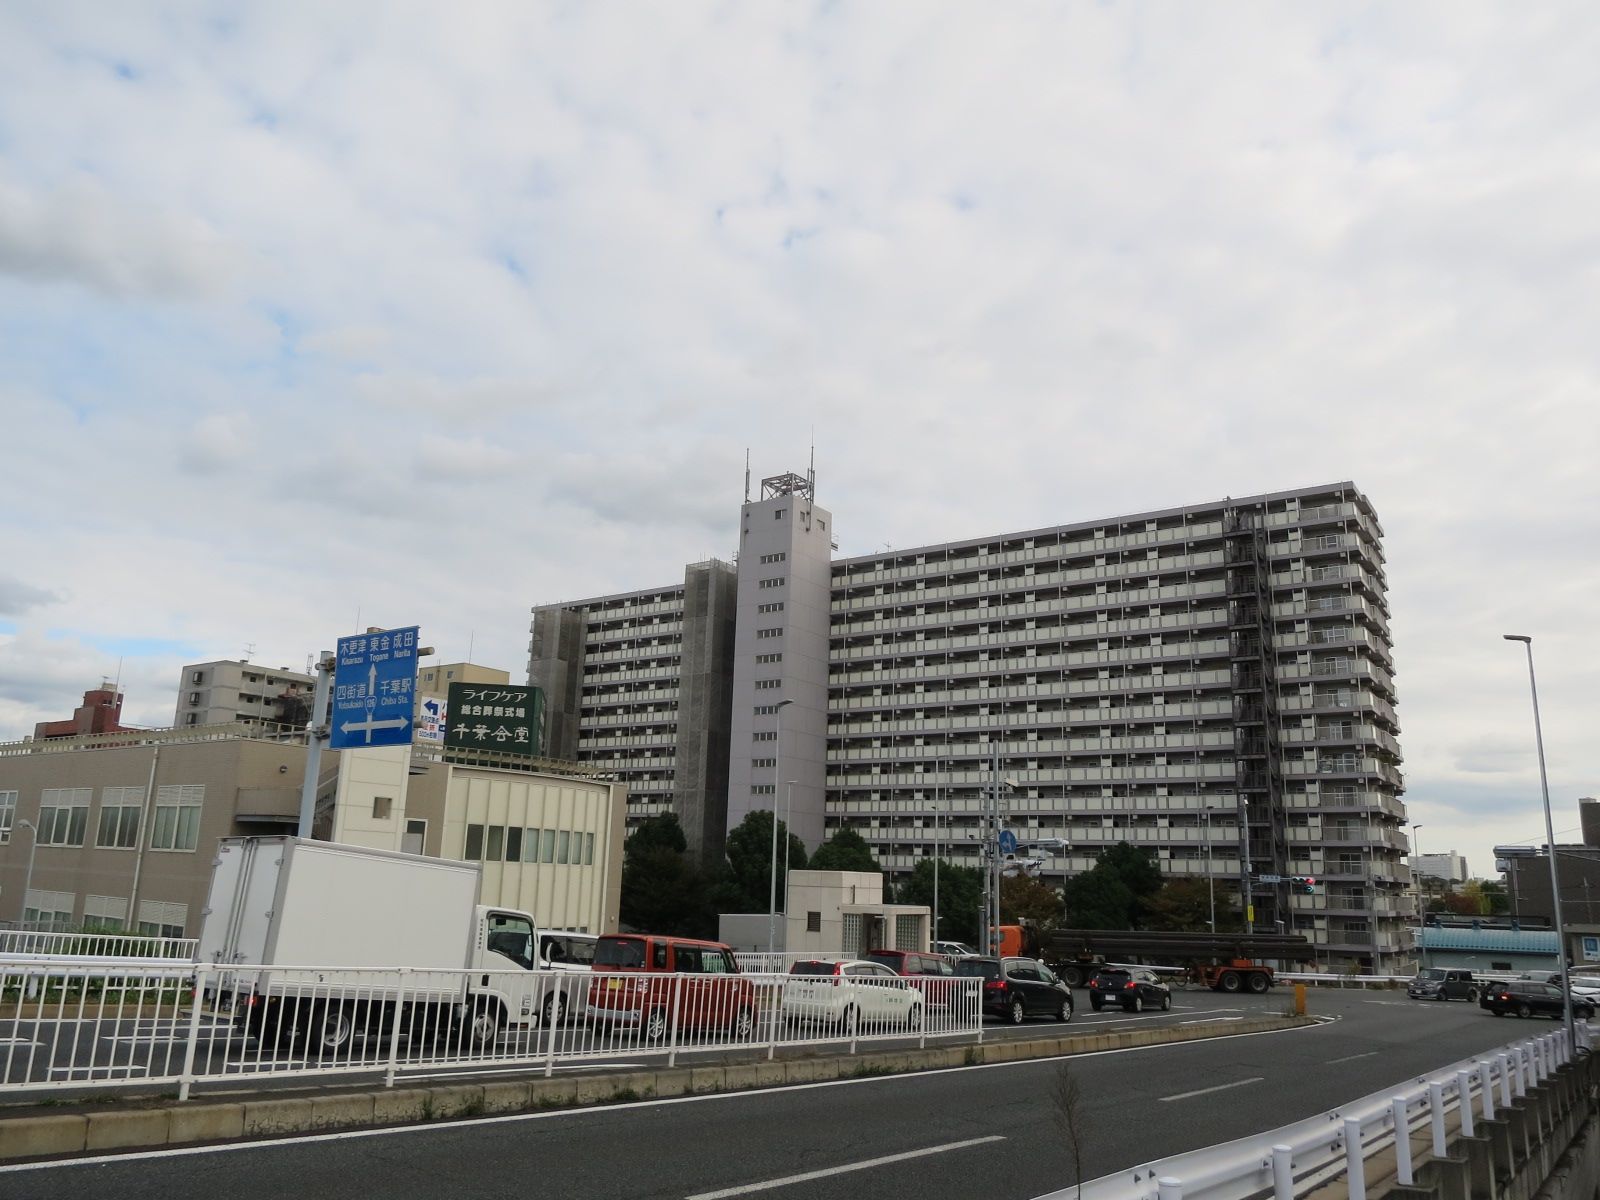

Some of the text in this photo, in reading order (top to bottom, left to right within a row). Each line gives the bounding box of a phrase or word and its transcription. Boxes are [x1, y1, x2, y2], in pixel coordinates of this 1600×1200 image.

[341, 639, 367, 656] 木更津
[369, 635, 390, 652] 東金
[393, 632, 413, 648] 成田
[394, 649, 411, 658] Narita
[337, 684, 367, 700] 四街道
[380, 677, 412, 695] 千葉駅
[462, 689, 528, 703] ライフケア
[460, 704, 526, 718] 総合葬祭式場
[452, 722, 529, 743] 千葉会堂
